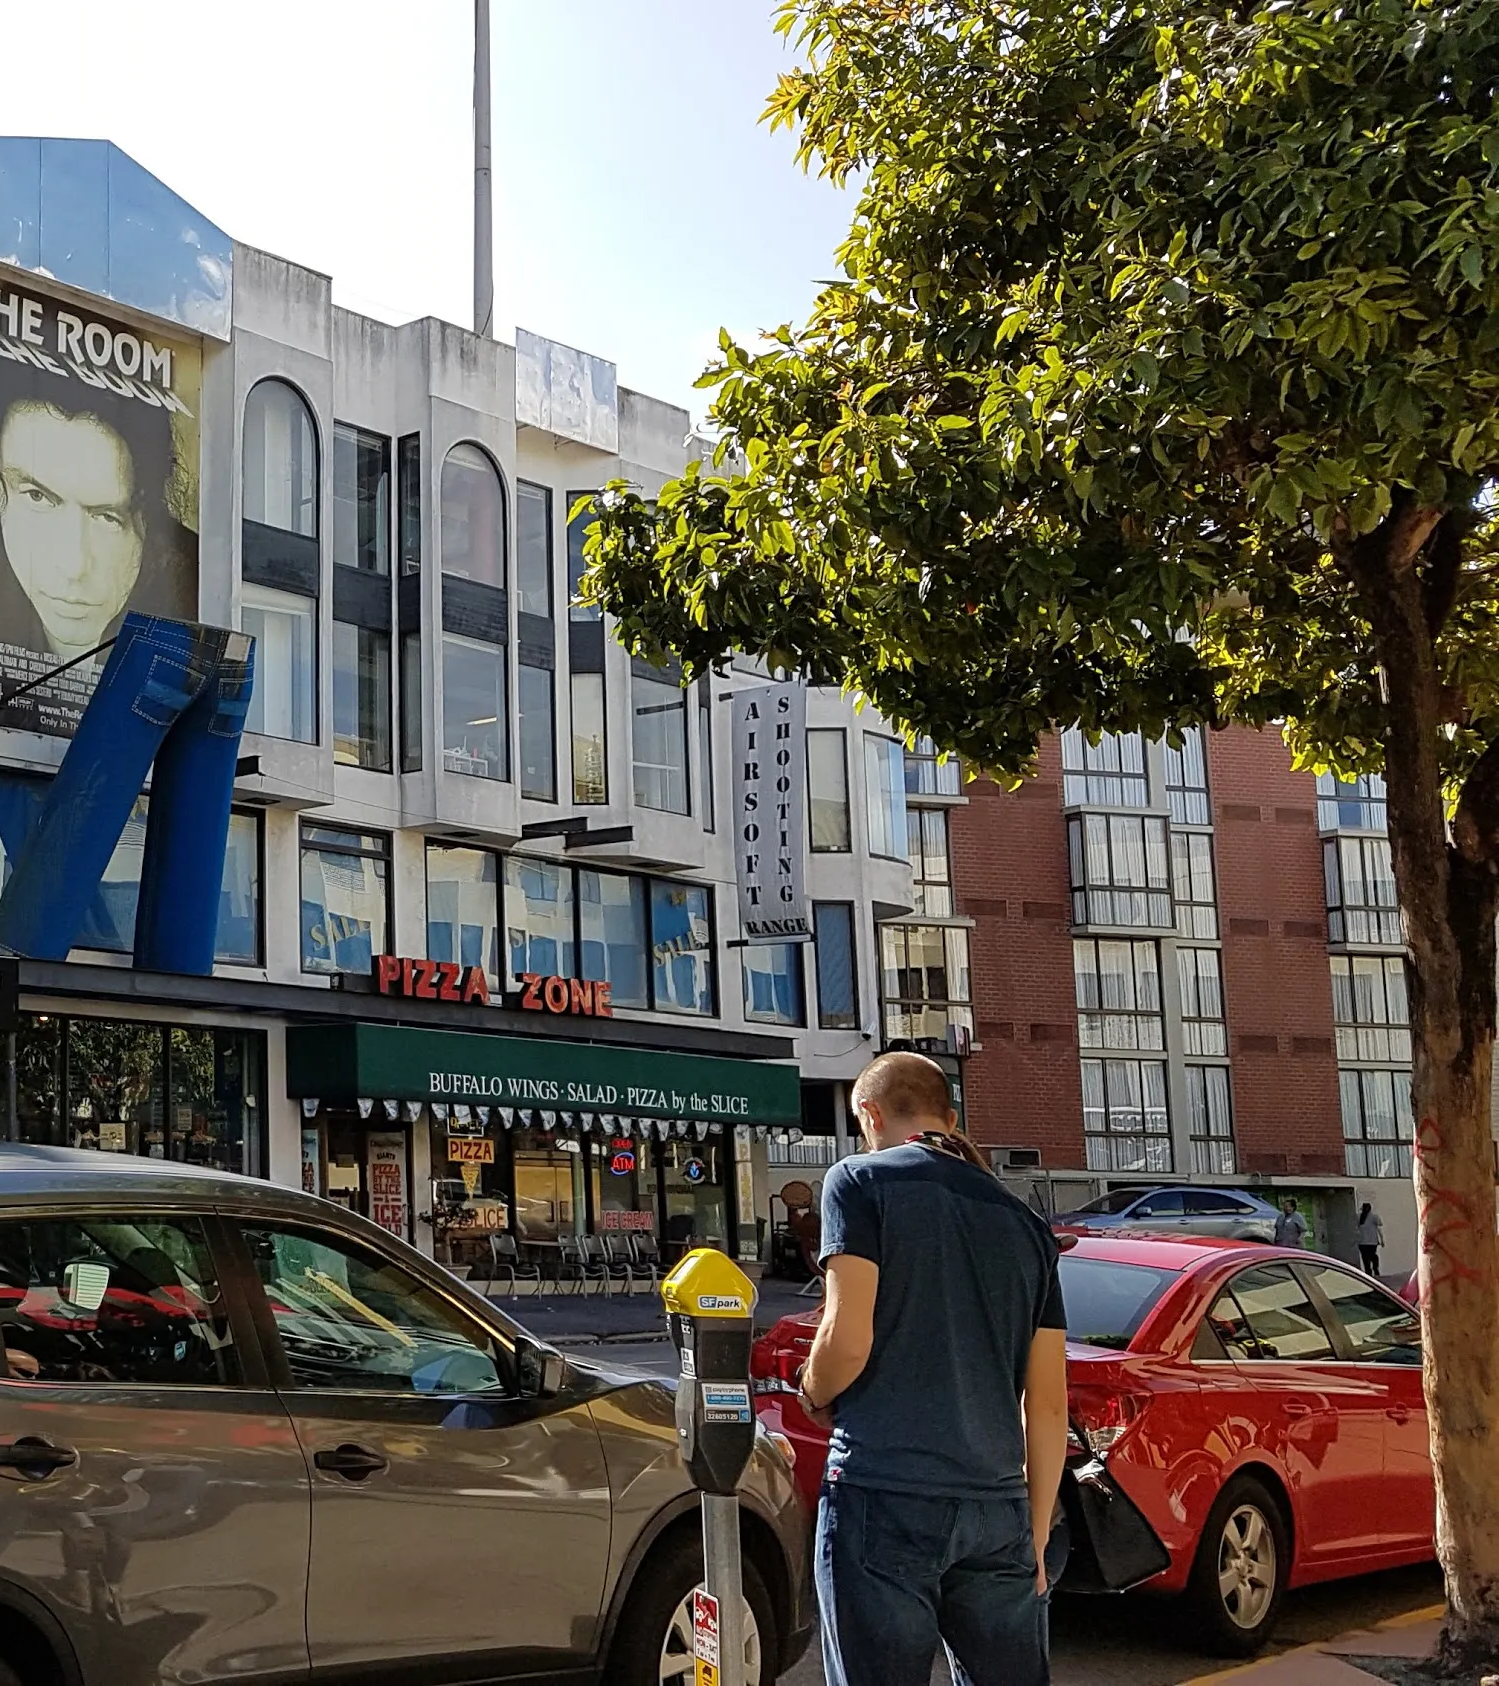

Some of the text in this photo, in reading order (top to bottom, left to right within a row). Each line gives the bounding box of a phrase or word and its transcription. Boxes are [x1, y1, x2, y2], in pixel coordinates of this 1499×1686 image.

[57, 311, 171, 388] ROOM
[40, 715, 58, 728] Only
[60, 719, 67, 728] In
[743, 701, 762, 906] AIRSOFT
[775, 696, 794, 903] SHOOTING
[745, 917, 808, 935] RANGE
[378, 955, 614, 1017] PIZZA ZONE
[429, 1072, 750, 1115] BUFFALO WINGS SALAD PIZZA by the SLICE
[450, 1141, 492, 1161] PIZZA
[373, 1164, 400, 1174] PIZZA
[612, 1157, 635, 1170] ATM
[373, 1184, 401, 1194] SLICE
[373, 1204, 402, 1224] ICE
[602, 1210, 653, 1230] ICE CREAM
